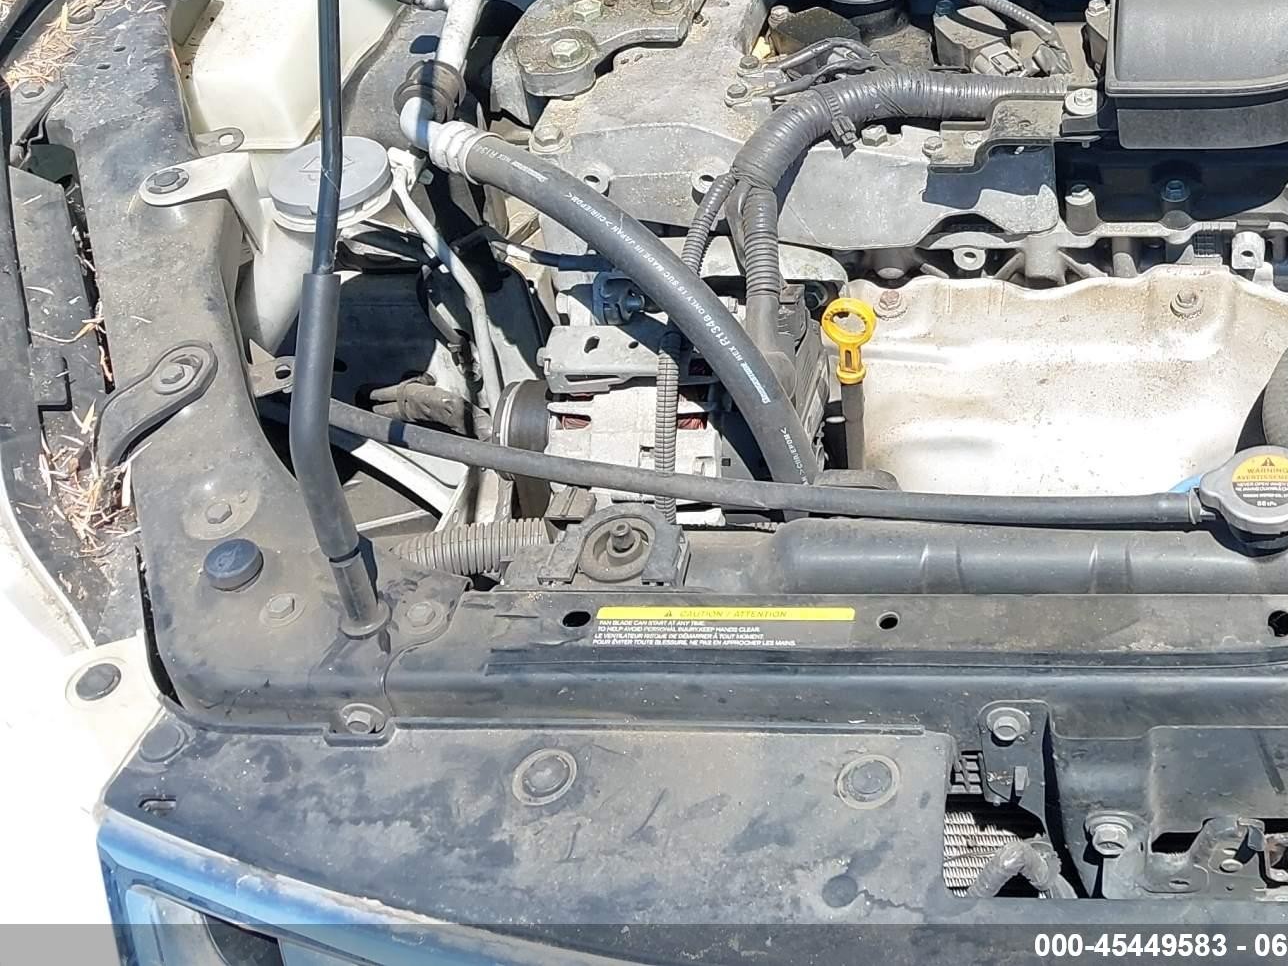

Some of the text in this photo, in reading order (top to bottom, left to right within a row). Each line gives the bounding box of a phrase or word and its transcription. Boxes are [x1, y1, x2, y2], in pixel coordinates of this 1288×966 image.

[612, 224, 637, 247] JAPAN
[643, 251, 665, 273] MADE
[684, 295, 705, 316] ONLY
[679, 610, 724, 618] CAUTION
[734, 610, 788, 618] ATTENTION
